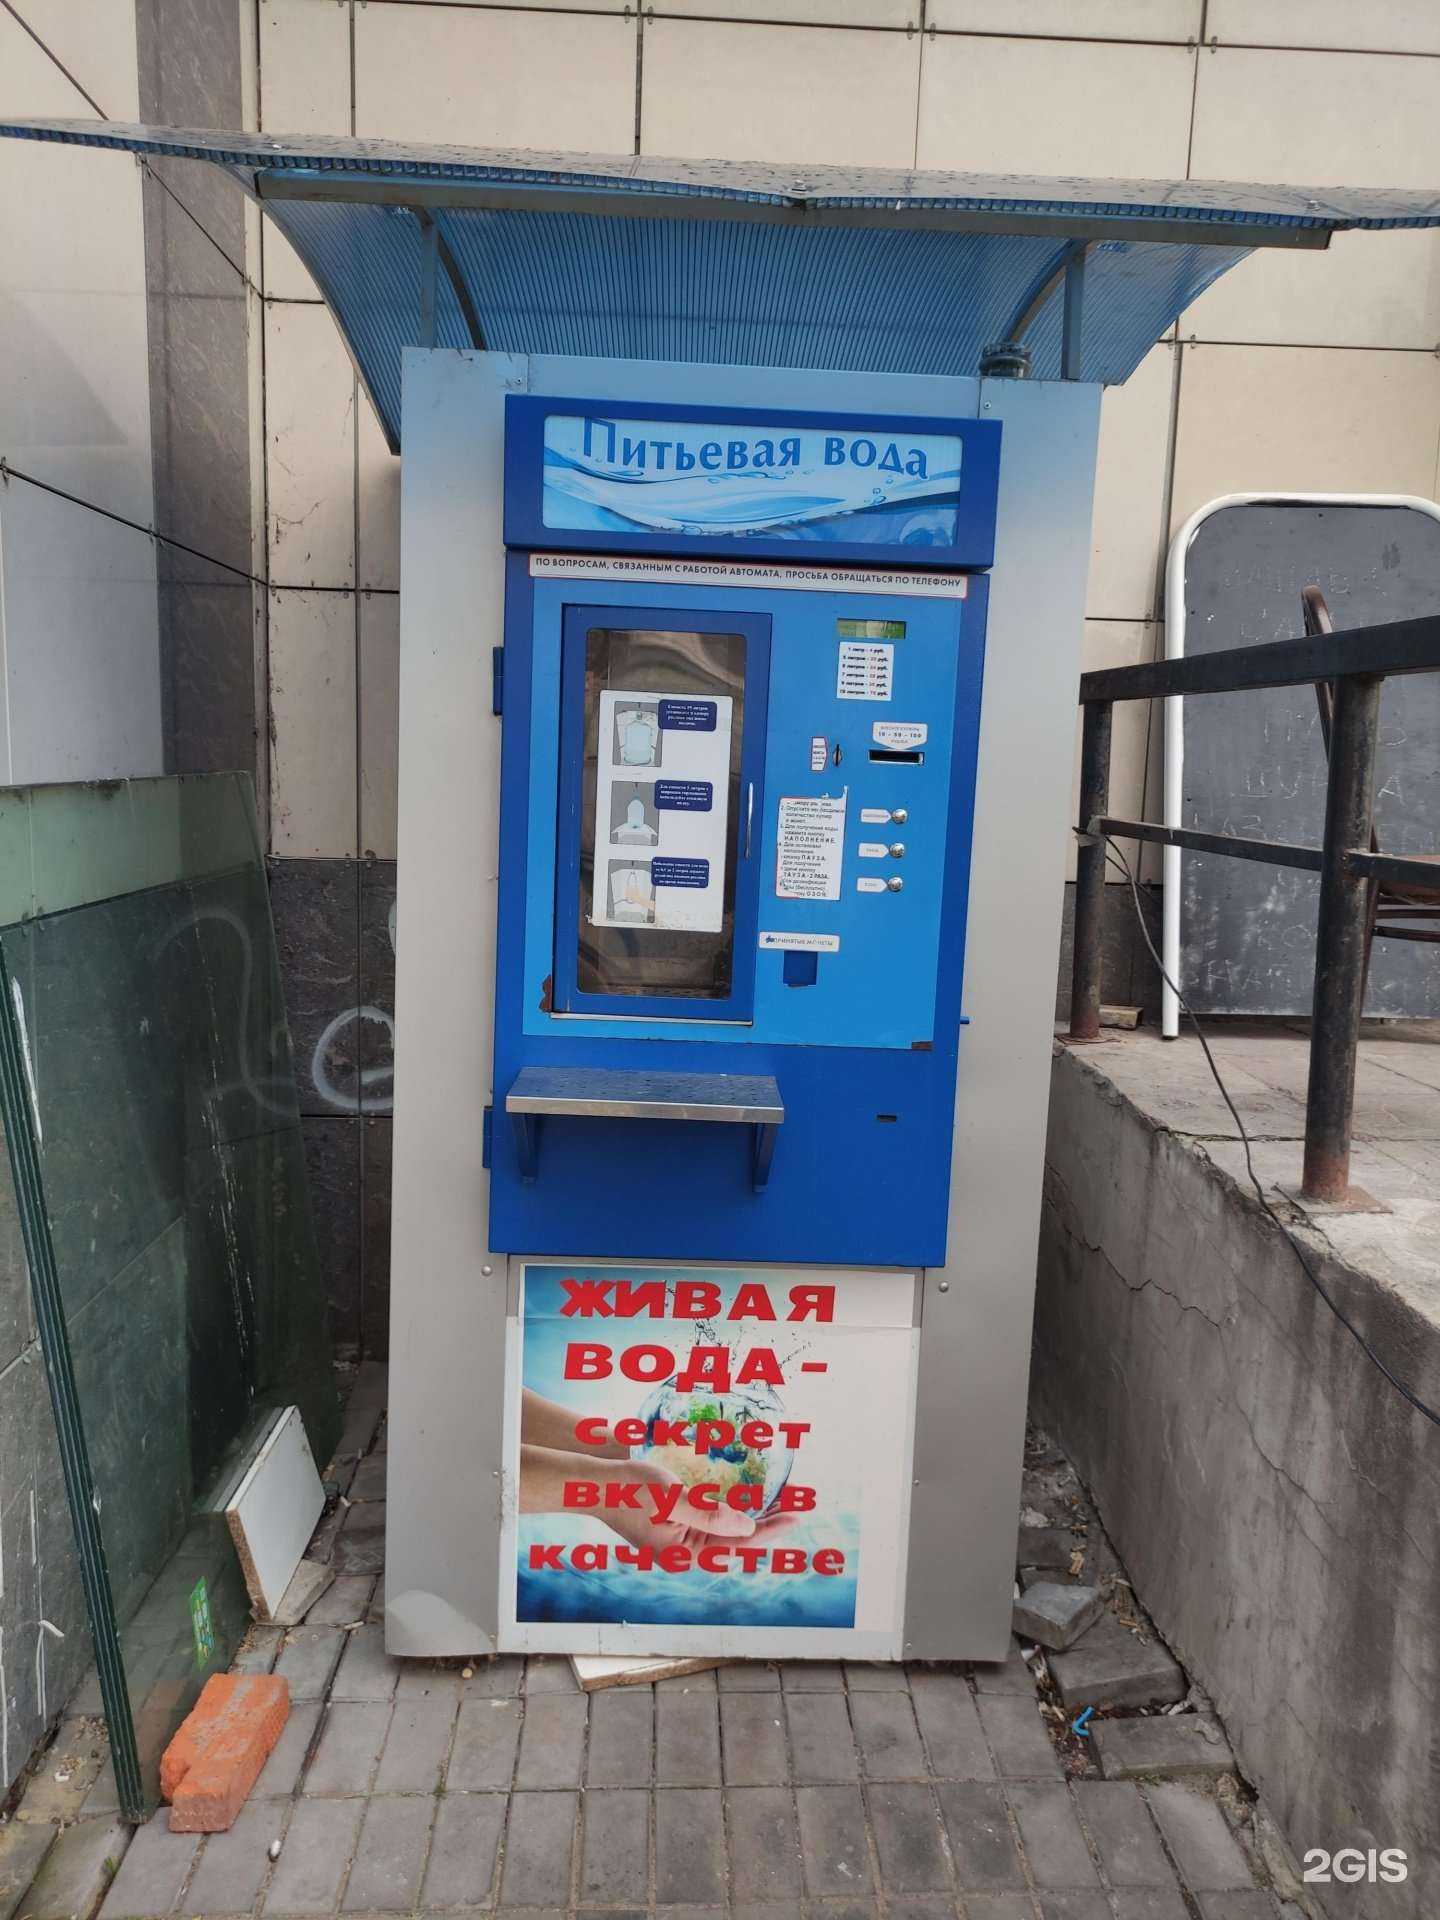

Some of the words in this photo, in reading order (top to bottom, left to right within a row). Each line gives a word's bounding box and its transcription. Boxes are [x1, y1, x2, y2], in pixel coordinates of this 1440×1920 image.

[583, 416, 801, 473] Питьевая
[824, 436, 929, 481] вода
[535, 557, 550, 567] ПО
[552, 558, 610, 570] ВОПРОСАМ,
[612, 561, 672, 572] СВЯЗАННЫМ
[674, 565, 681, 573] С
[682, 564, 727, 575] РАБОТОЙ
[729, 568, 782, 579] АВТОМАТА,
[785, 570, 828, 581] ПРОСЬБА
[831, 572, 893, 584] ОБРАЩАТЬСЯ
[895, 575, 910, 585] ПО
[911, 576, 961, 588] ТЕЛЕФОНУ
[559, 1278, 836, 1323] ЖИВАЯ
[563, 1342, 785, 1393] ВОДА
[574, 1417, 811, 1455] секрет
[562, 1481, 764, 1525] вкуса
[780, 1485, 818, 1512] в
[529, 1543, 846, 1576] качестве
